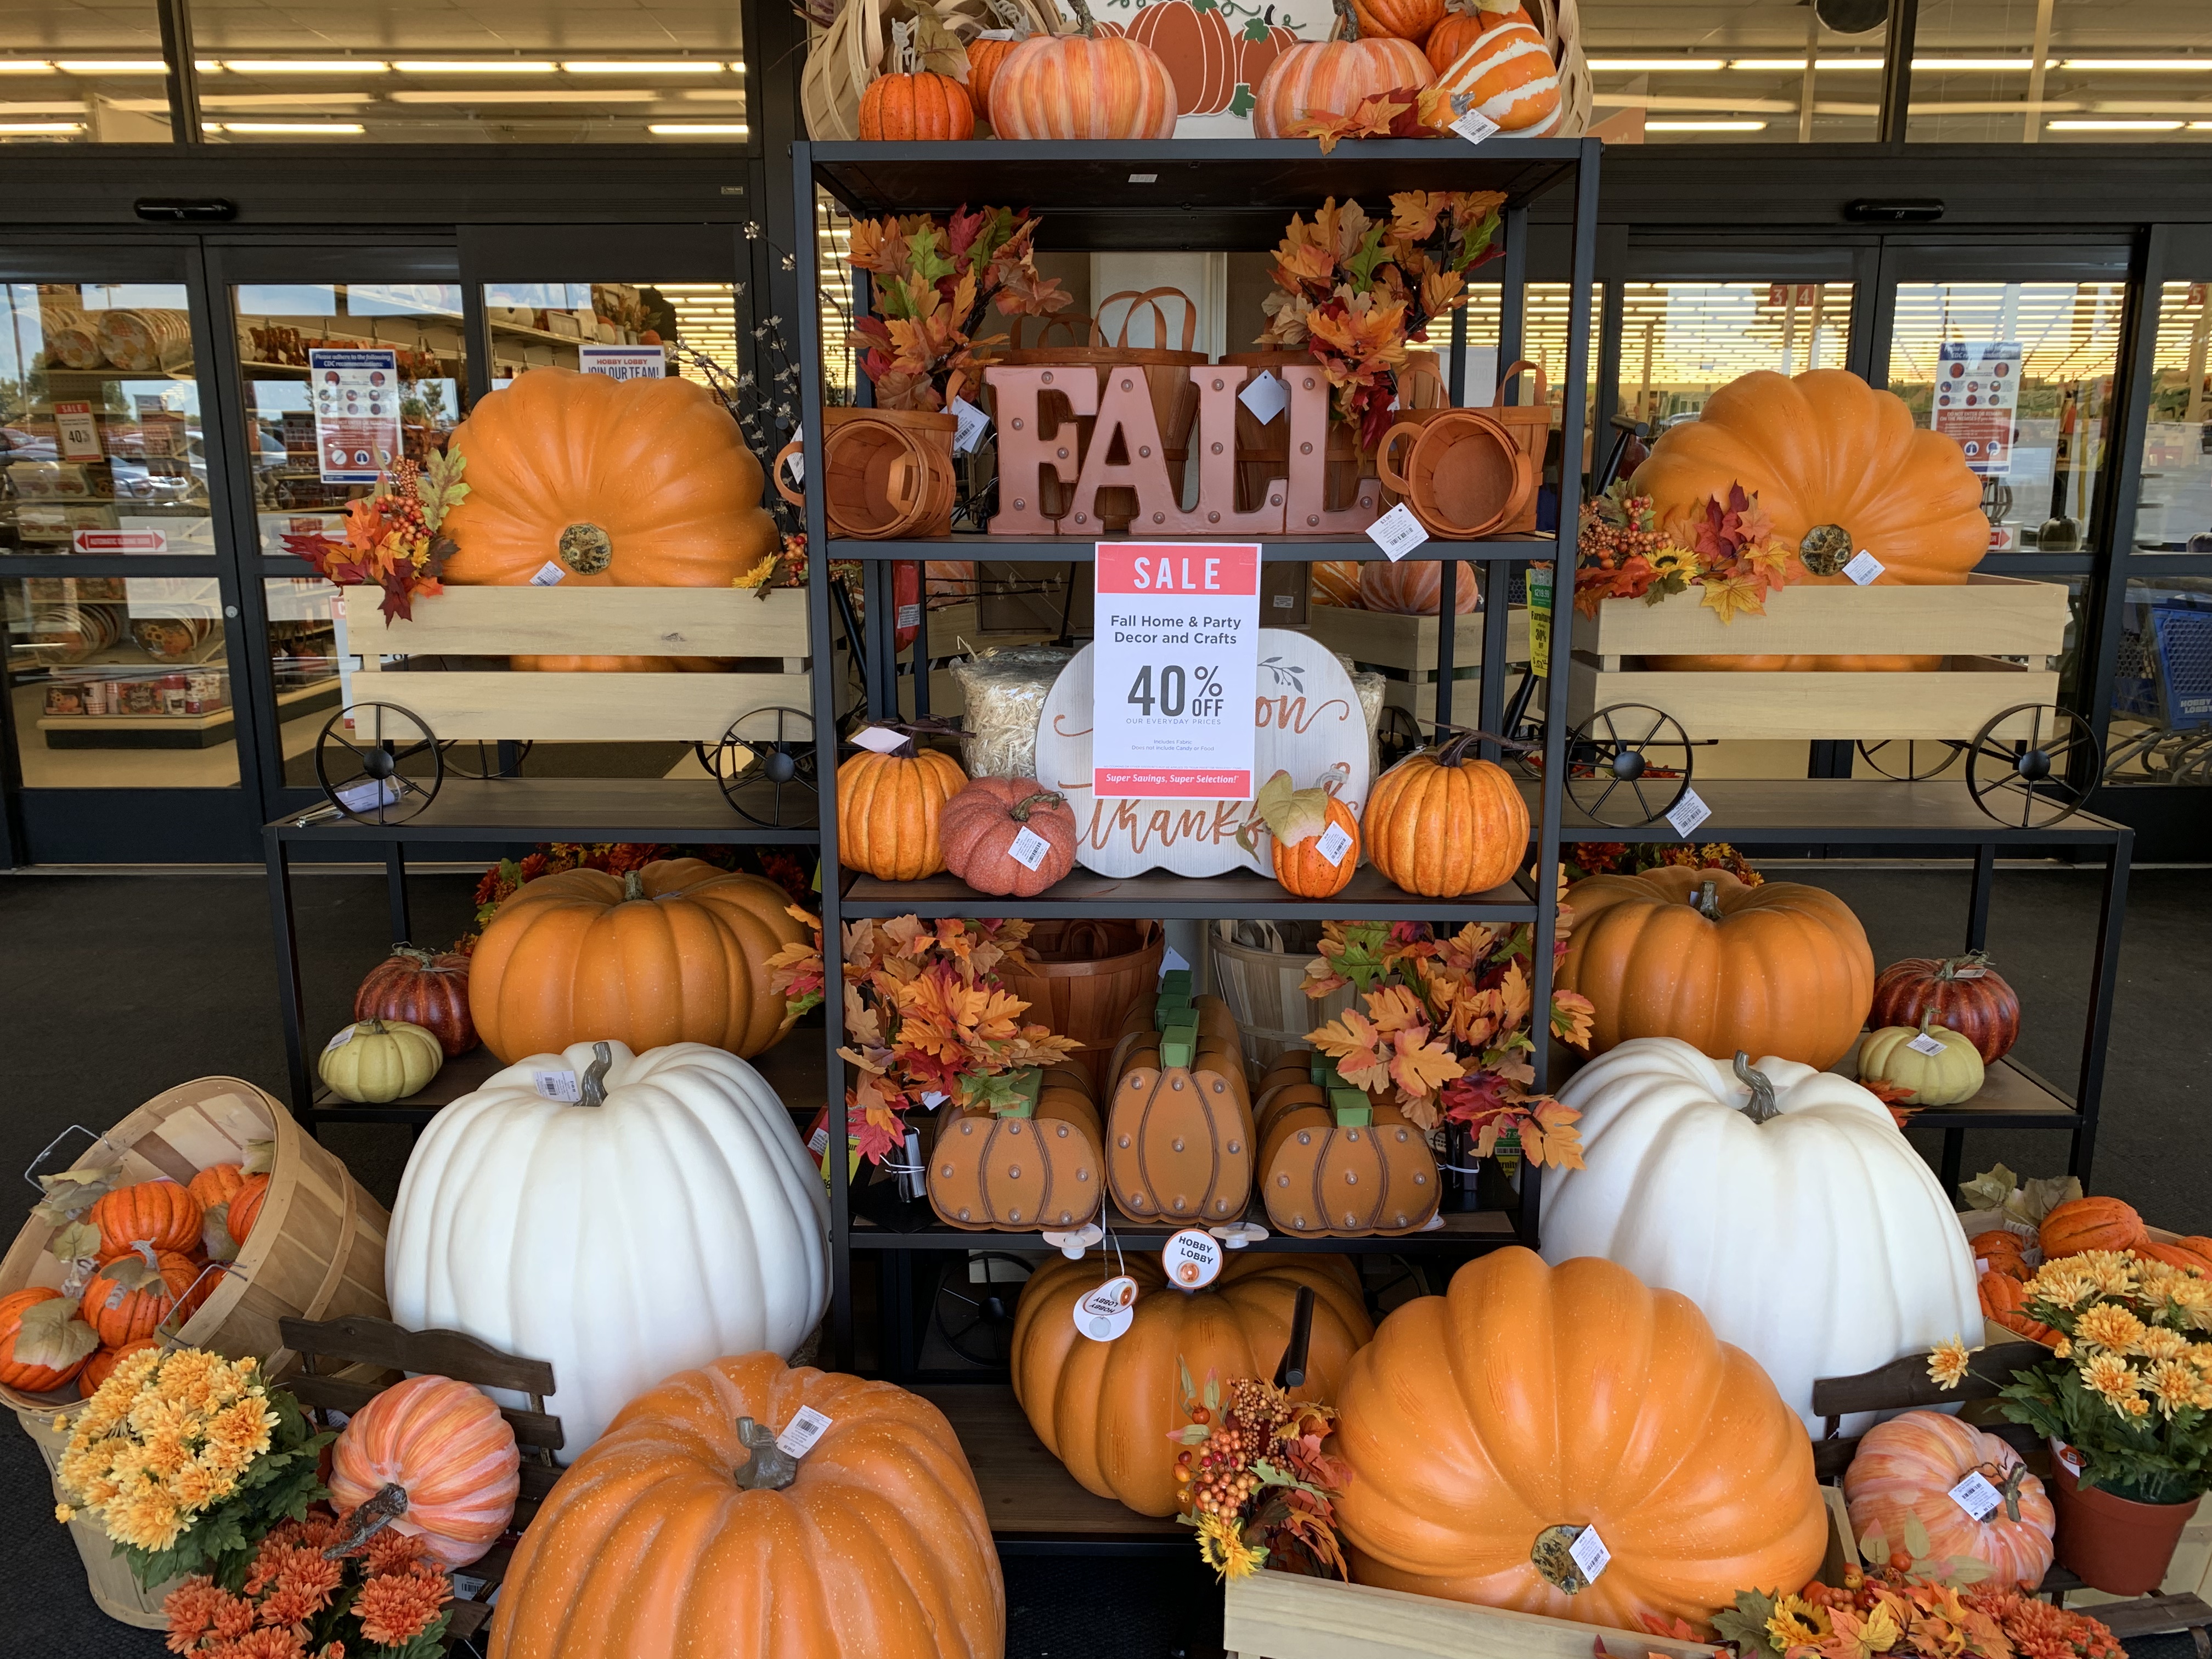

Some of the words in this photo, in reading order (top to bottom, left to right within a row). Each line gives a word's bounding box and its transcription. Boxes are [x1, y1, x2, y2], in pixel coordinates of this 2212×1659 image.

[1773, 289, 1783, 306] 3
[1799, 288, 1810, 304] 4
[2191, 287, 2201, 303] 5
[609, 366, 627, 379] OUR
[631, 366, 659, 379] TEAM!
[61, 404, 83, 413] SALE
[985, 363, 1380, 536] FALL
[1133, 557, 1221, 590] SALE
[1111, 615, 1136, 627] Fall
[1142, 616, 1184, 628] Home
[1188, 616, 1198, 628] &
[1204, 616, 1241, 631] Party
[1115, 632, 1158, 643] Decor
[1162, 631, 1189, 644] and
[1194, 633, 1237, 645] Crafts
[1536, 628, 1547, 643] 30%
[1192, 698, 1224, 717] OFF
[1106, 773, 1131, 783] Super
[1132, 774, 1168, 784] Savings,
[1169, 774, 1194, 785] Super
[1196, 775, 1238, 784] Selection!
[1178, 1235, 1213, 1253] HOBBY
[1180, 1247, 1214, 1265] LOBBY
[1088, 1303, 1115, 1314] HOBBY
[1094, 1297, 1118, 1307] LOBBY
